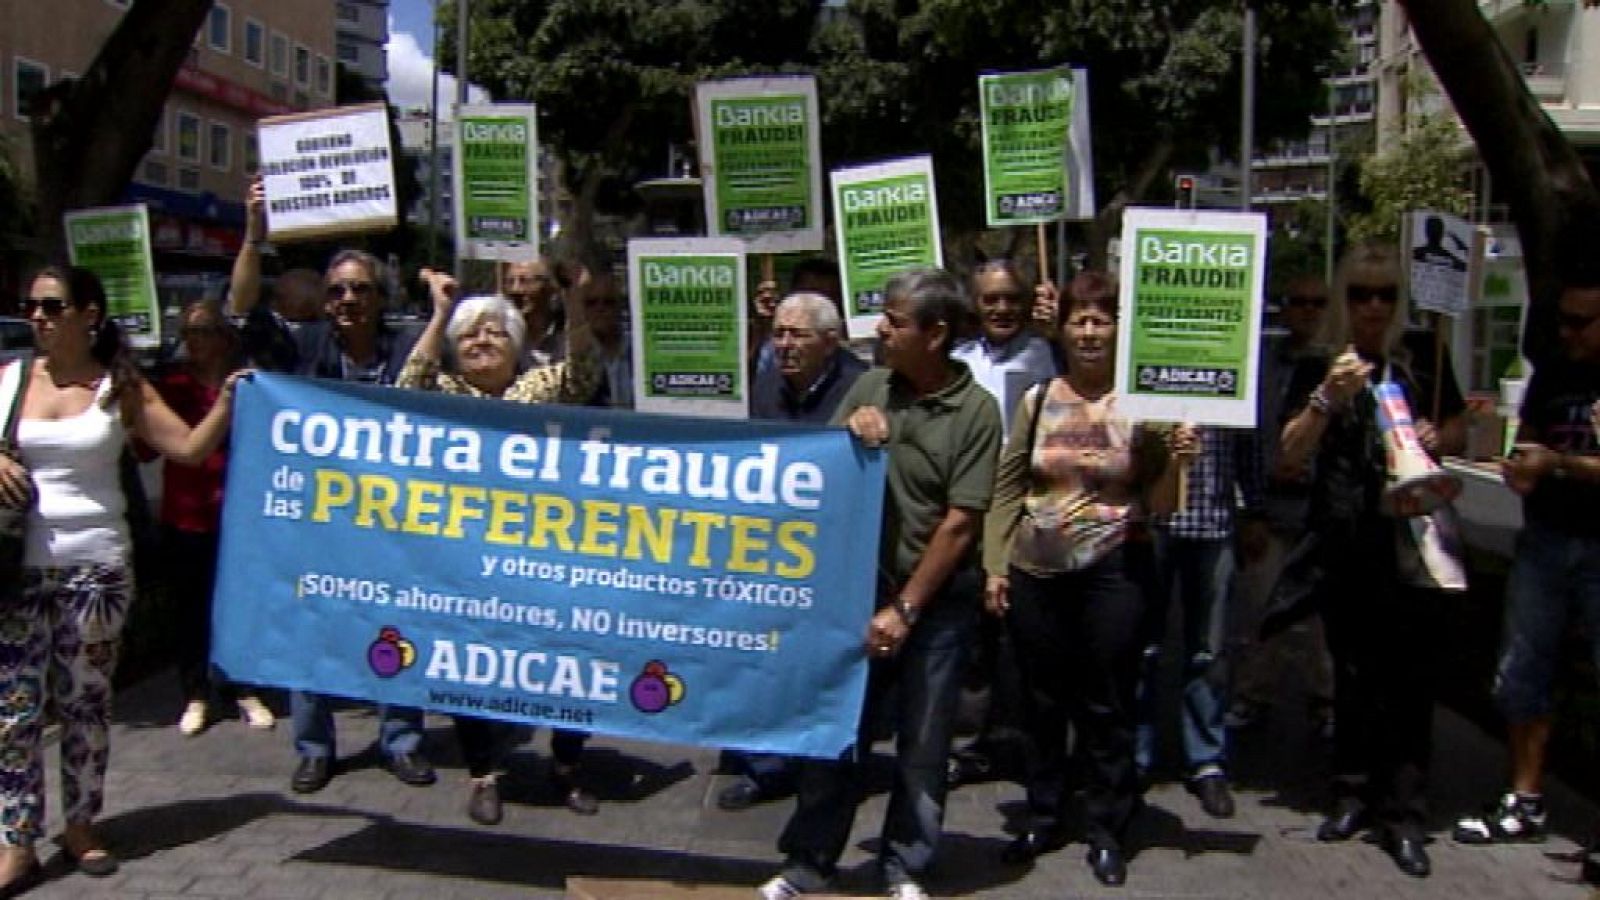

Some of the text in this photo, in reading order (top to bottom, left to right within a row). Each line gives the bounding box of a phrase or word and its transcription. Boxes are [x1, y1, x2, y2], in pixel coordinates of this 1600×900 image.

[717, 104, 803, 128] Bankia
[464, 121, 526, 142] Bankia
[719, 125, 803, 145] FRAUDE!
[299, 169, 356, 190] 100% DE
[271, 193, 331, 213] NUESTROS
[843, 182, 927, 213] Bankia
[1140, 236, 1249, 267] Bankia
[643, 262, 733, 288] Bankia
[1140, 266, 1246, 290] FRAUDE!
[646, 287, 733, 306] FRAUDE!
[1158, 367, 1217, 385] ADICAE
[271, 408, 825, 510] contra el fraude
[272, 465, 305, 492] de
[262, 491, 303, 520] las
[311, 468, 818, 579] PREFERENTES
[481, 554, 814, 609] y otros productos TÓXICOS
[297, 574, 781, 654] ¡SOMOS ahorradores, NO inversores!
[424, 640, 622, 702] ADICAE
[428, 689, 594, 725] www.adicae.net
